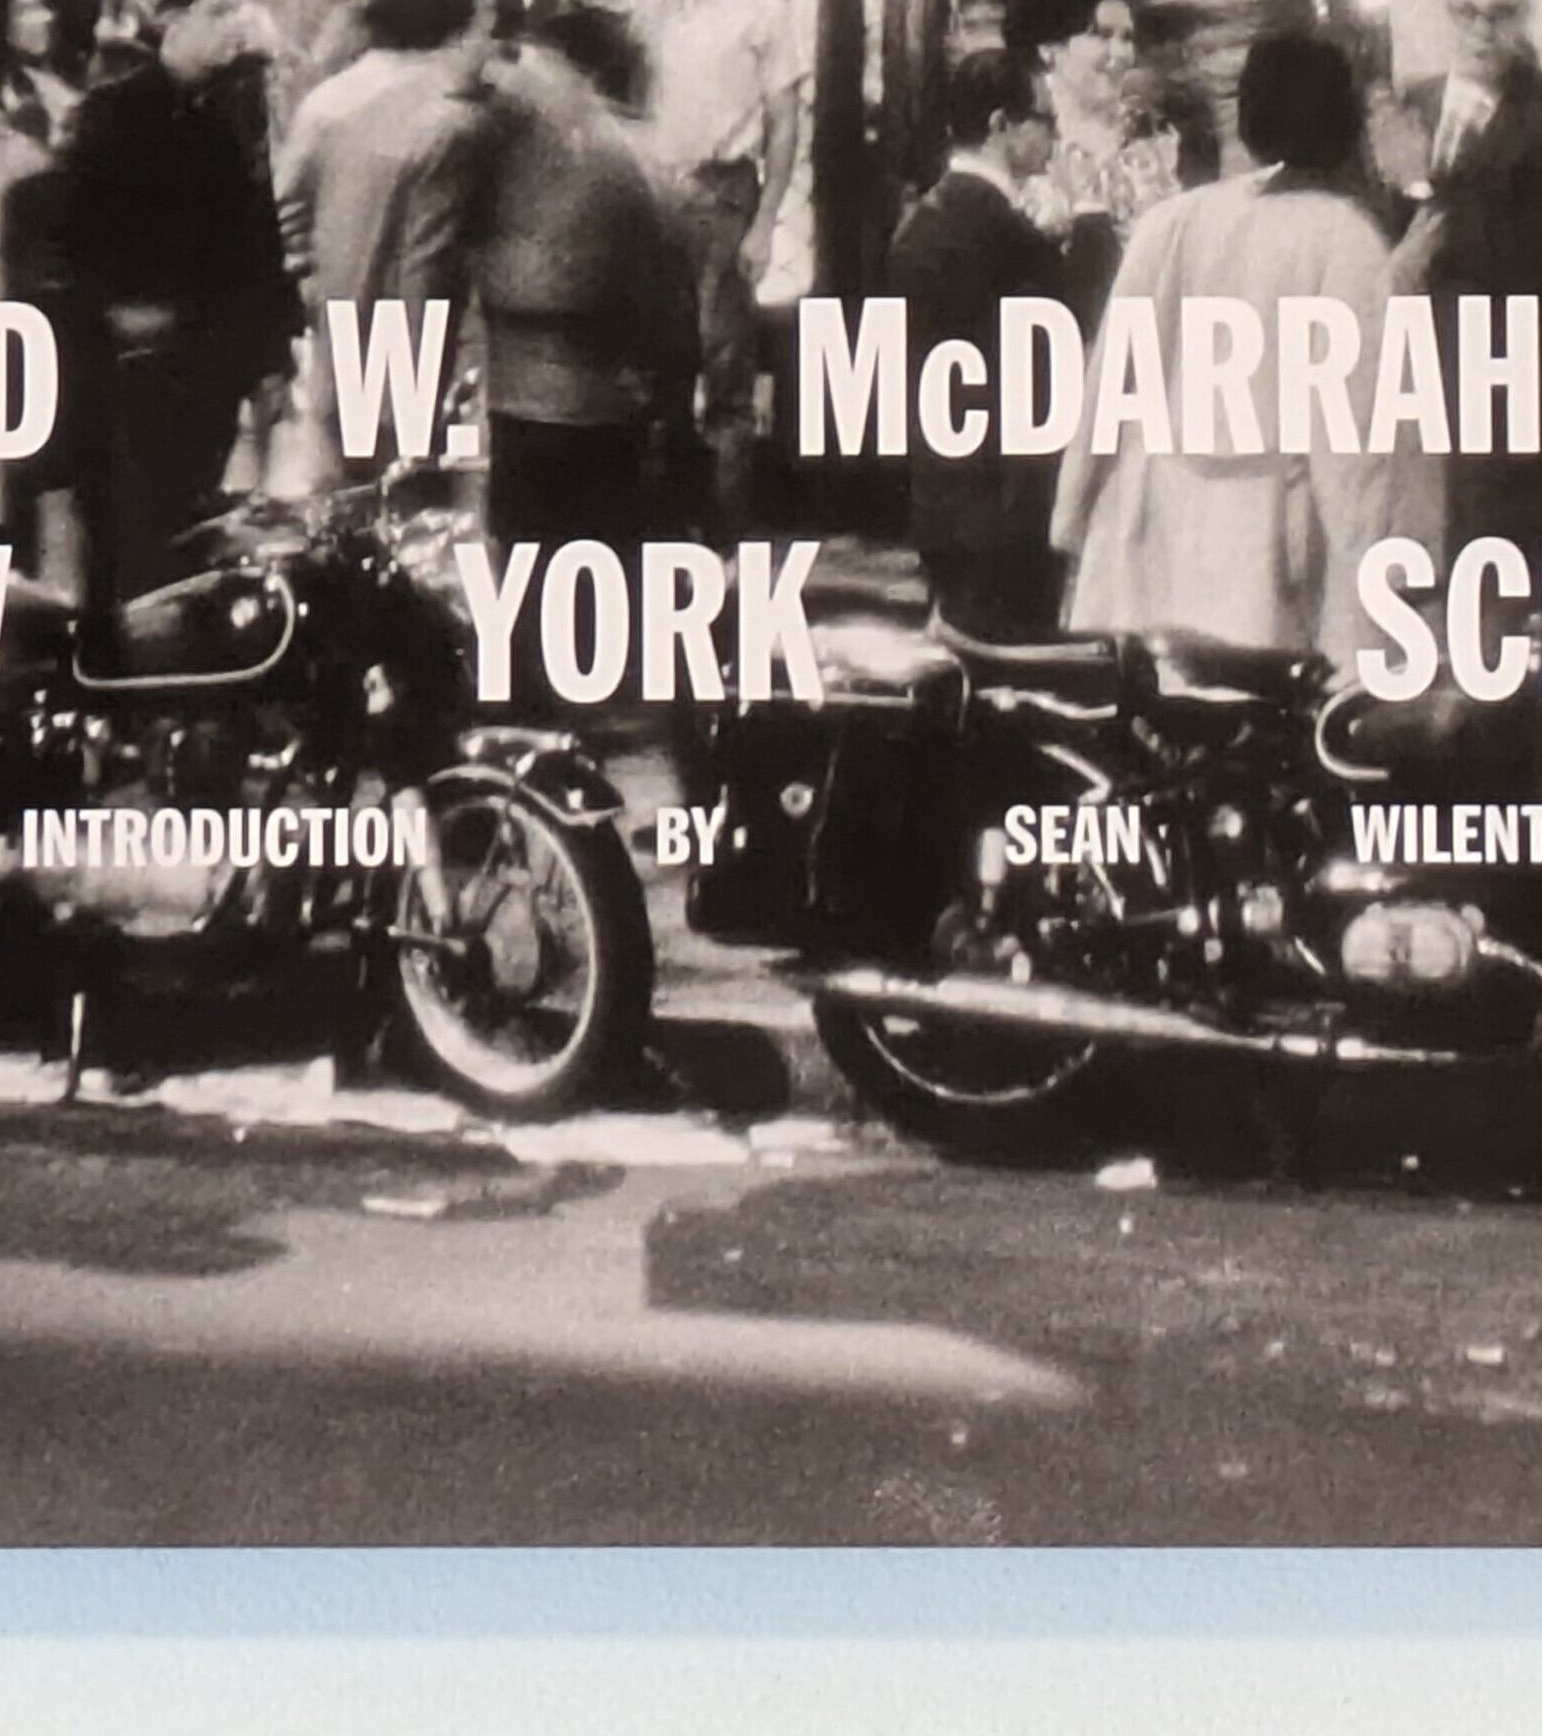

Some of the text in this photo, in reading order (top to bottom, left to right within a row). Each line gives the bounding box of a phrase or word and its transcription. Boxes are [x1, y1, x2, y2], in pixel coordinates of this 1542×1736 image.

[326, 298, 480, 468] W.
[797, 294, 1542, 457] McDARRAH
[452, 539, 825, 703] YORK
[22, 804, 429, 870] INTRODUCTION
[656, 804, 725, 866] BY
[1004, 804, 1141, 865] SEAN
